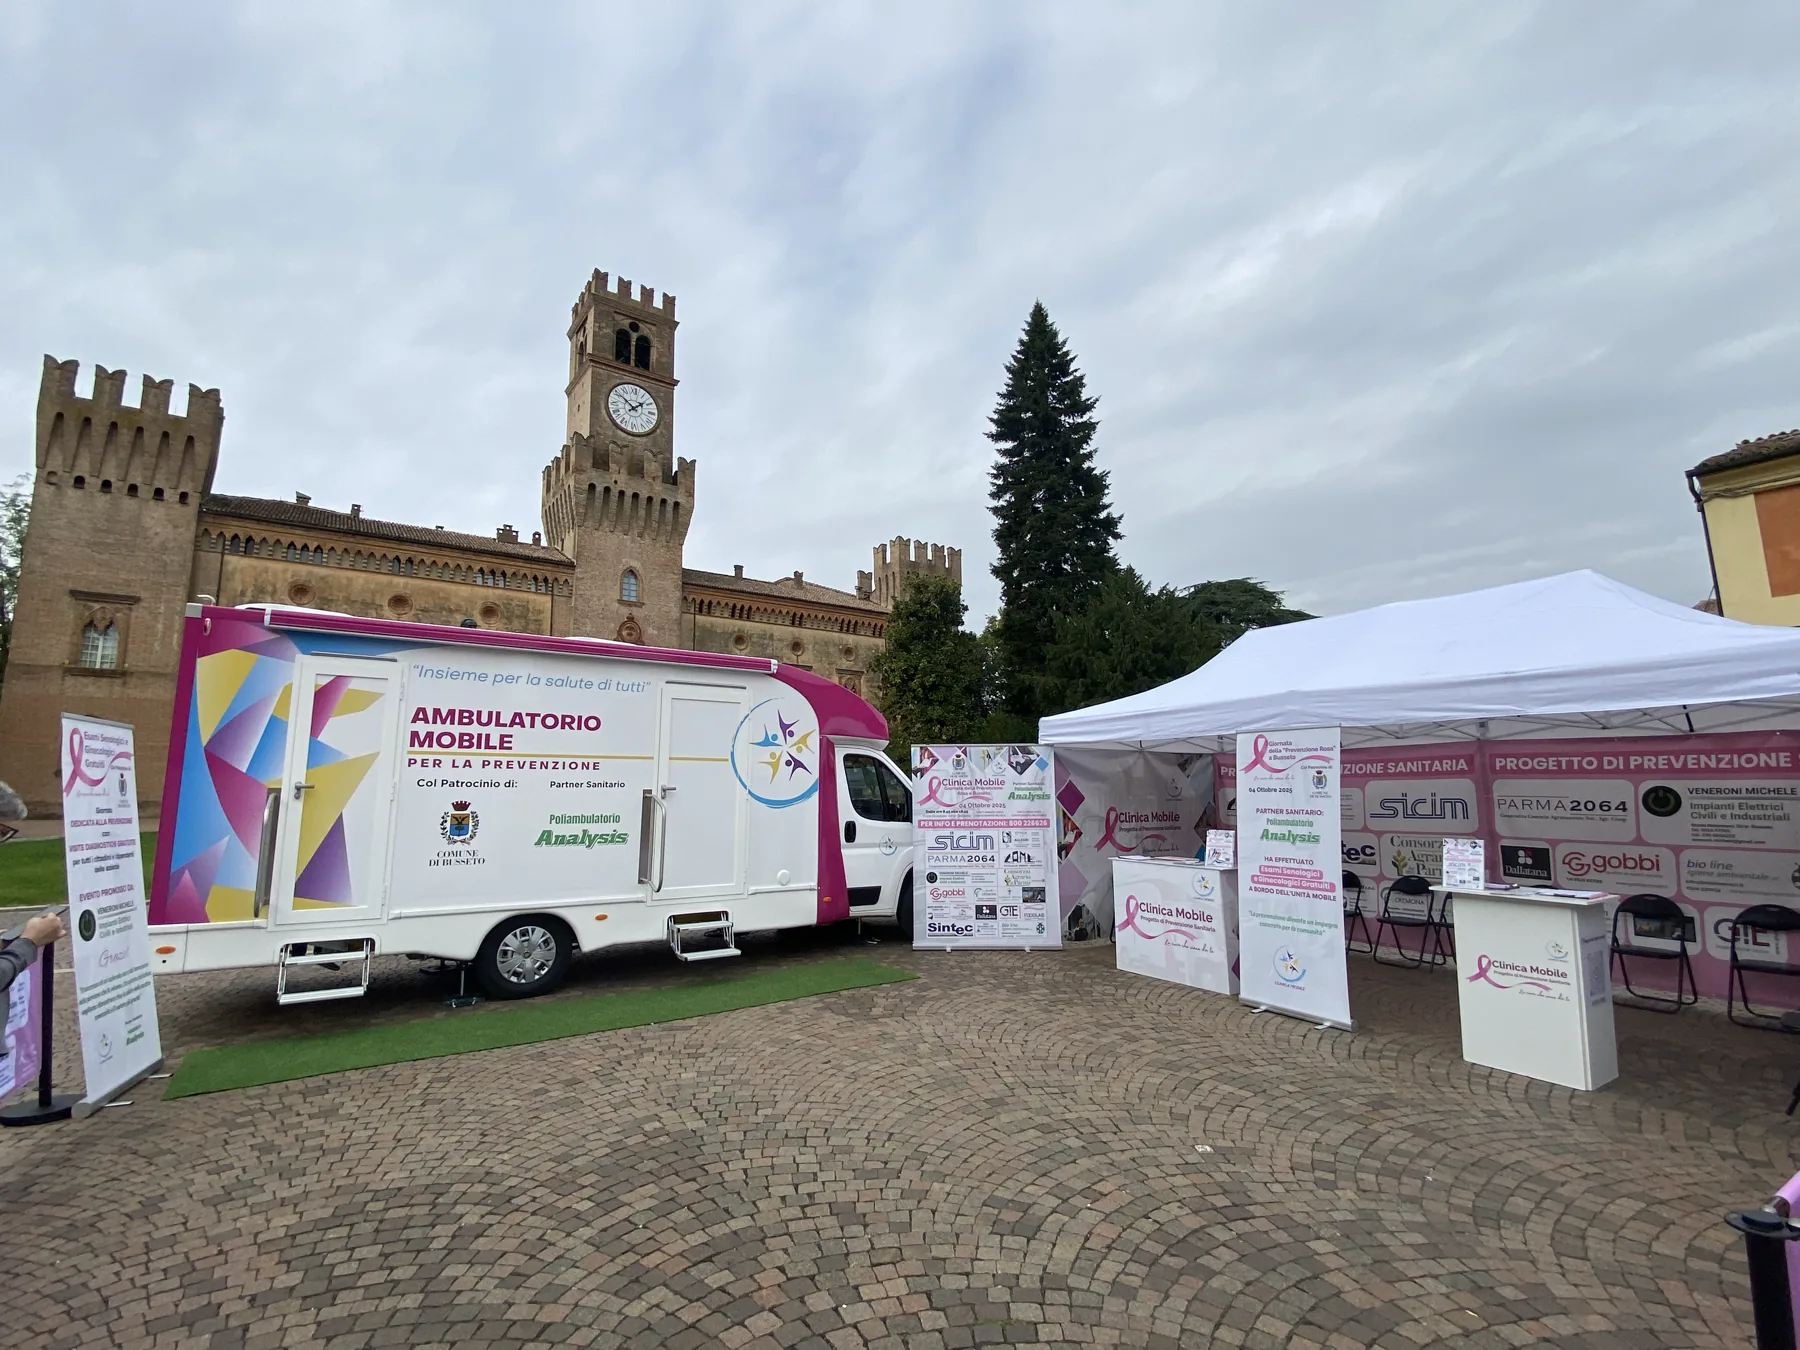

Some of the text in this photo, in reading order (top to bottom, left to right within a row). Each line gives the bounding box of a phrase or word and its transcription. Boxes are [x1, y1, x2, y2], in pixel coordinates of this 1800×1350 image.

[492, 674, 522, 686] per
[526, 673, 541, 686] la
[545, 676, 594, 690] salute
[598, 679, 612, 690] di
[410, 707, 602, 731] AMBULATORIO
[409, 730, 513, 750] MOBILE
[408, 758, 600, 770] PER LA PREVENZIONE
[1387, 759, 1469, 773] SANITARIA
[1496, 752, 1792, 770] PROGETTO DI PREVENZIONE
[416, 779, 518, 788] Col Patrocinio di:
[550, 780, 626, 788] Partner Sanitario
[942, 778, 1006, 787] Clinica Mobile
[1008, 792, 1050, 801] Analysis
[1370, 792, 1469, 819] sicim
[1690, 802, 1784, 811] Impianti Elettrici
[549, 812, 620, 824] Poliambulatorio
[1119, 812, 1180, 823] Clinica Mobile
[1731, 812, 1790, 821] Industriali
[1266, 818, 1313, 827] Poliambulatorio
[534, 829, 630, 850] Analysis
[927, 832, 994, 850] sicim
[1260, 828, 1321, 846] Analysis
[436, 850, 479, 858] COMUNE
[442, 858, 486, 866] BUSSETO
[1275, 857, 1314, 865] EFFETTUATO
[1592, 853, 1660, 873] gobbi
[1687, 859, 1733, 870] bio line
[1283, 868, 1320, 878] Senologici
[1505, 865, 1547, 877] Dallatana
[1259, 876, 1300, 887] Ginecologici
[1301, 881, 1330, 889] Gratuiti
[79, 891, 100, 902] EVENTO
[942, 889, 965, 898] gobbi
[1276, 889, 1311, 898] DELL'UNITÀ
[1140, 902, 1213, 922] Clinica Mobile
[1256, 913, 1286, 921] prevenzione
[928, 923, 973, 934] Sintec
[1165, 919, 1193, 928] Prevenzione
[1194, 924, 1216, 932] Sanitaria
[1492, 960, 1568, 978] Clinica Mobile
